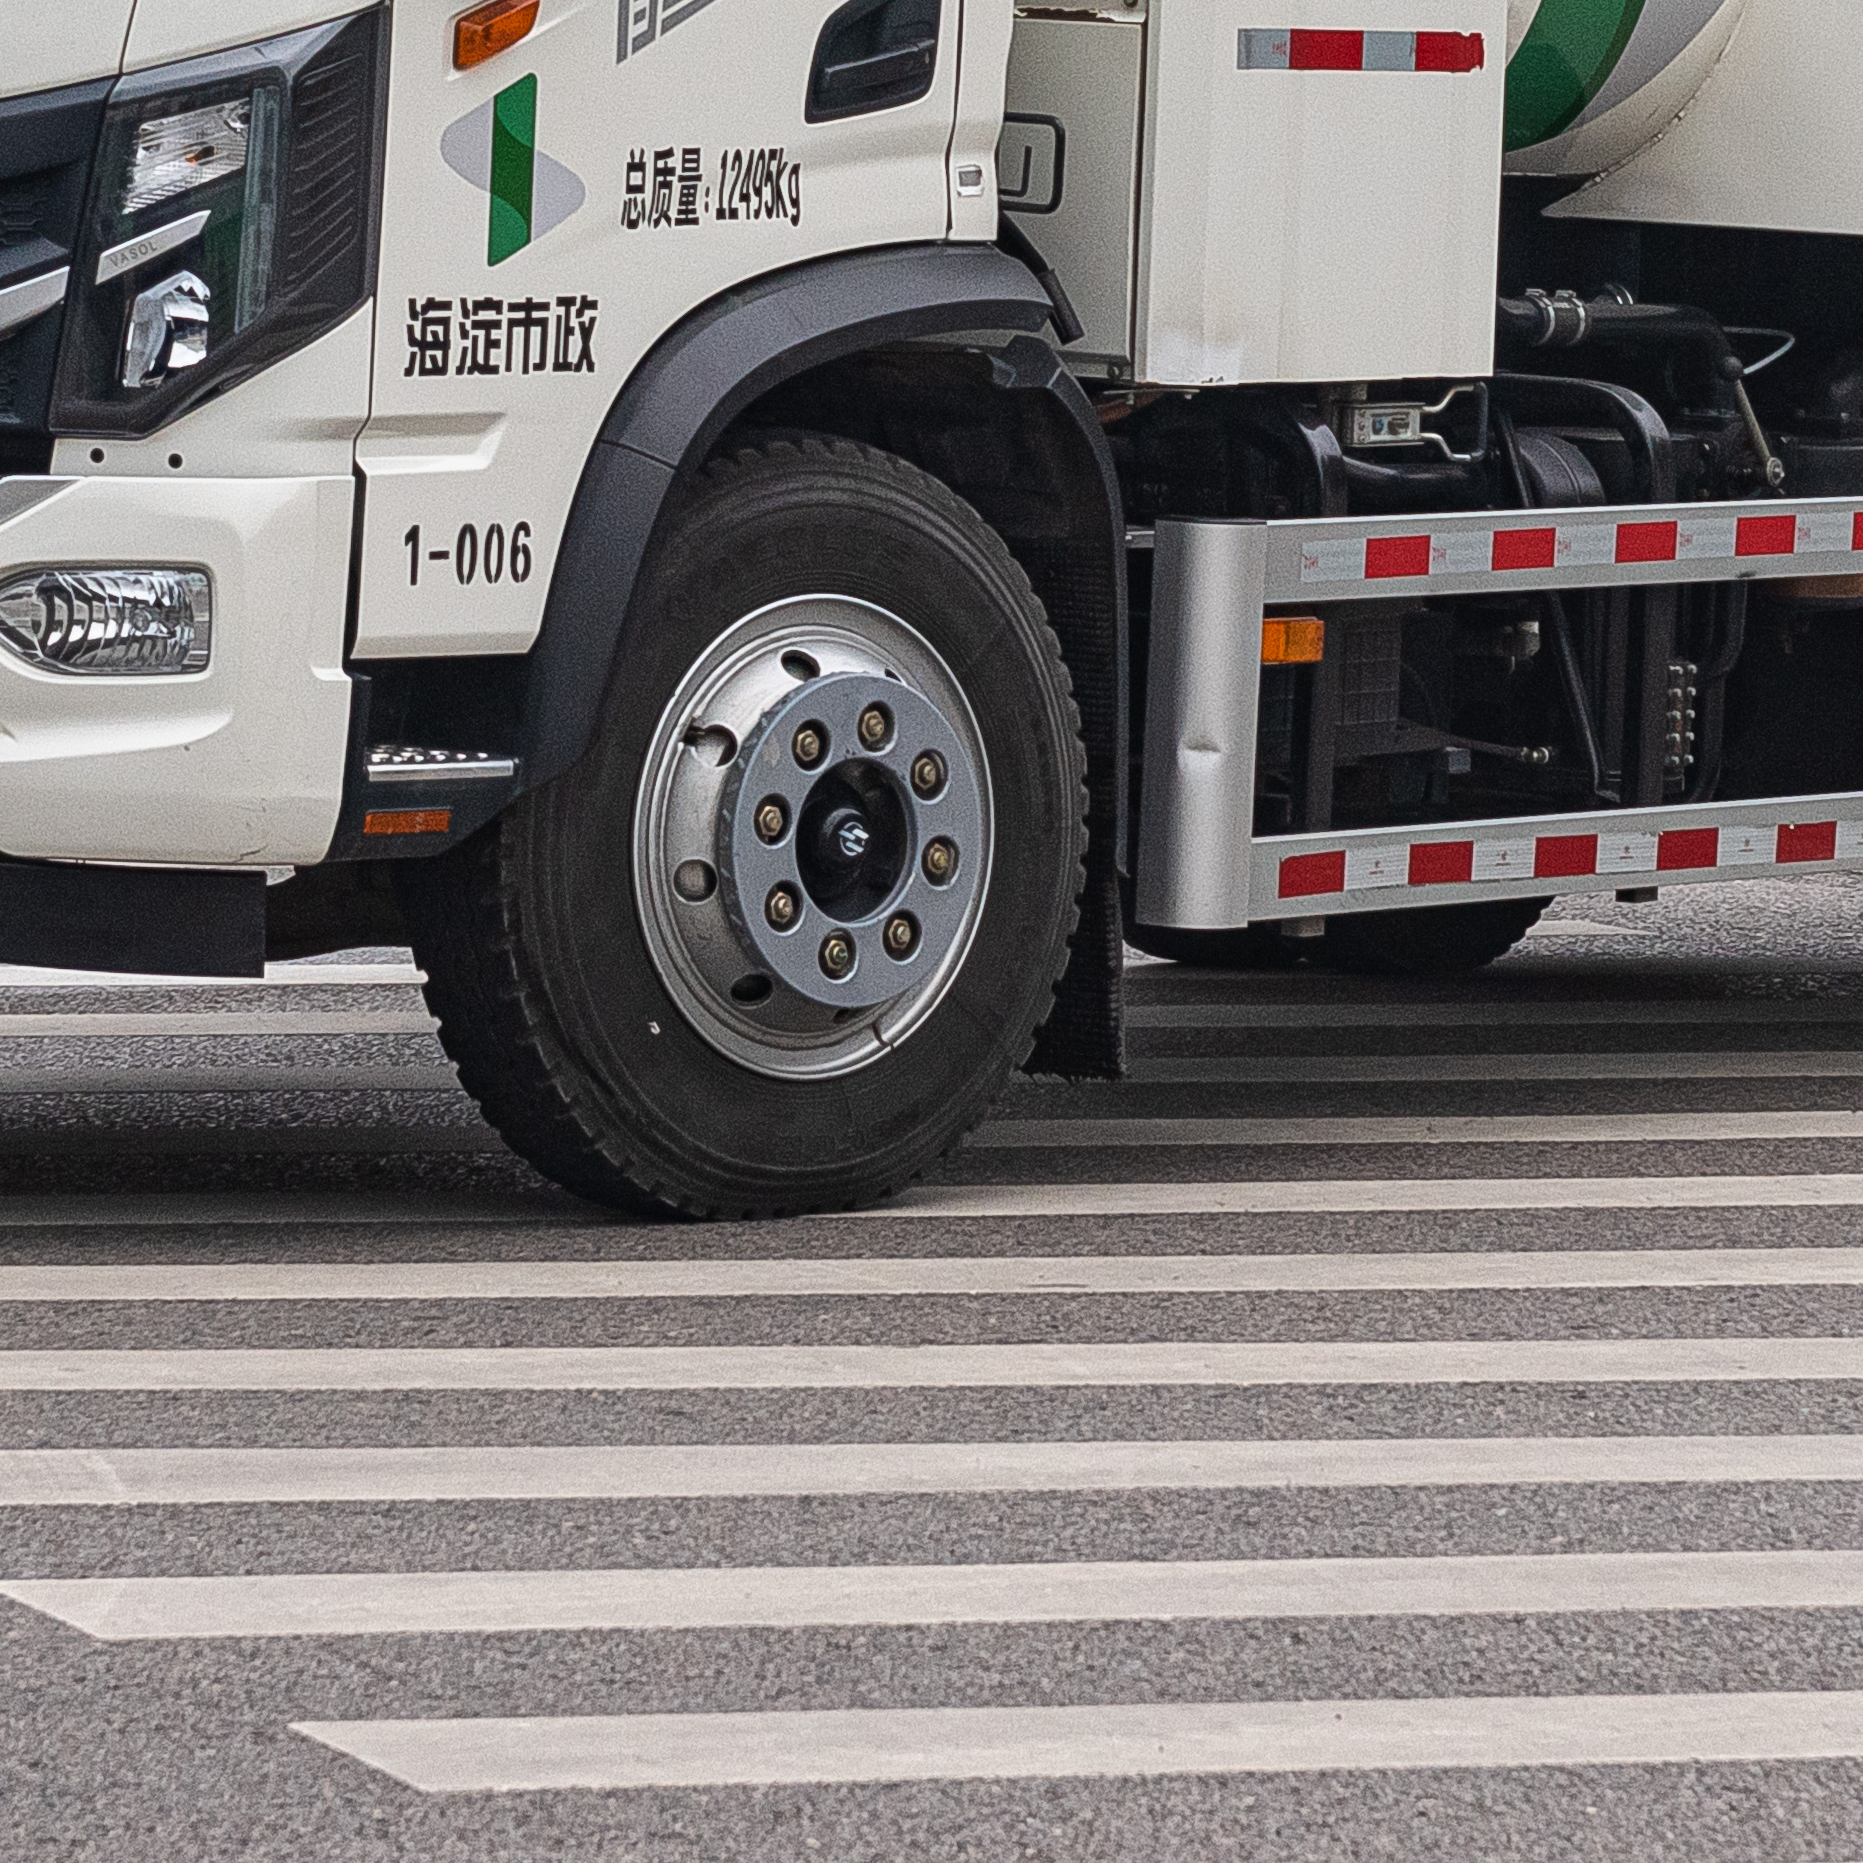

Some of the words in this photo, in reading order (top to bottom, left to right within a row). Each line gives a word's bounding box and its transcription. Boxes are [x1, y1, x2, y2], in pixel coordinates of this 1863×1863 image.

[109, 240, 158, 267] VASOL
[403, 294, 599, 377] 海淀市政
[403, 520, 532, 586] 1-006
